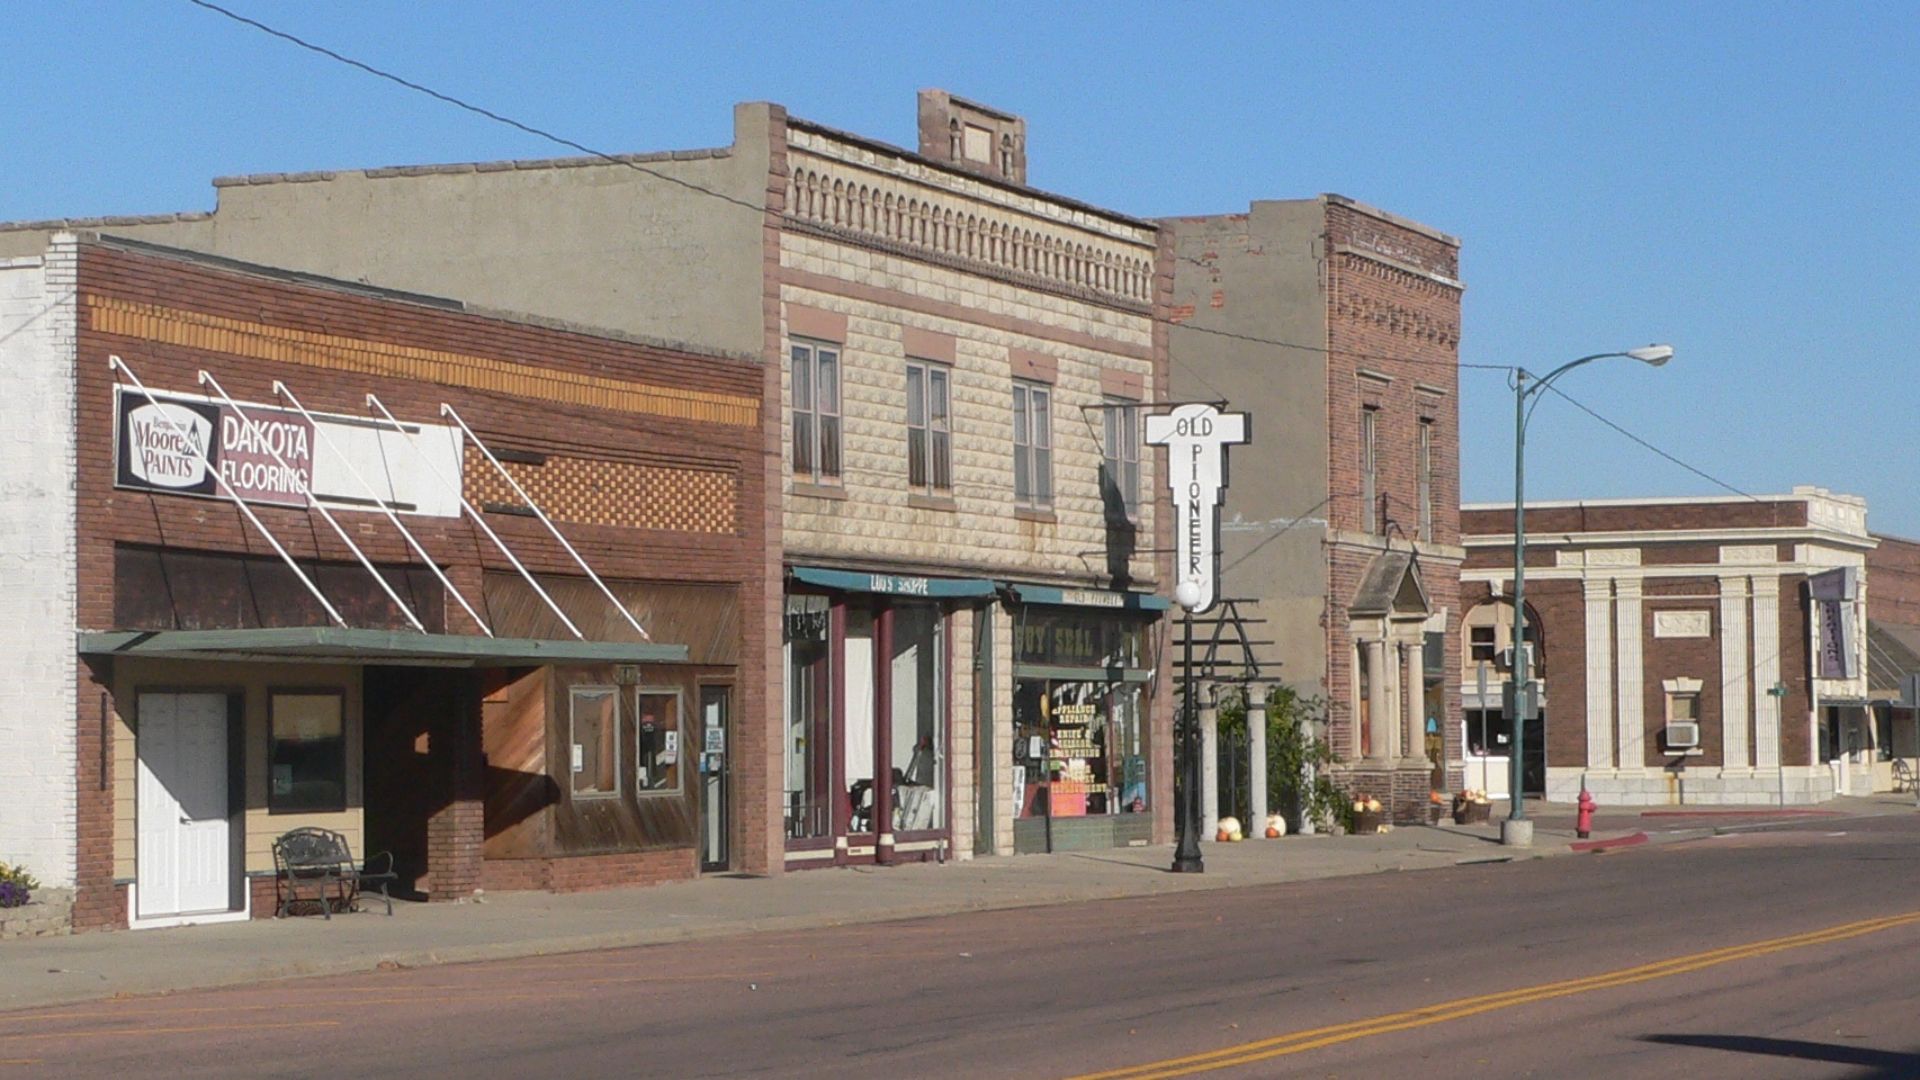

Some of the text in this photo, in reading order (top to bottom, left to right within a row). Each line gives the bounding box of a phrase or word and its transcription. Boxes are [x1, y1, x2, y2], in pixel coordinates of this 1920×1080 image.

[136, 420, 184, 452] Moore
[223, 415, 309, 460] DAKOTA
[1176, 416, 1213, 437] OLD
[144, 449, 193, 478] PAINTS
[221, 459, 309, 495] FLOORING
[1189, 443, 1202, 575] PIONEER
[1055, 628, 1094, 657] SELL
